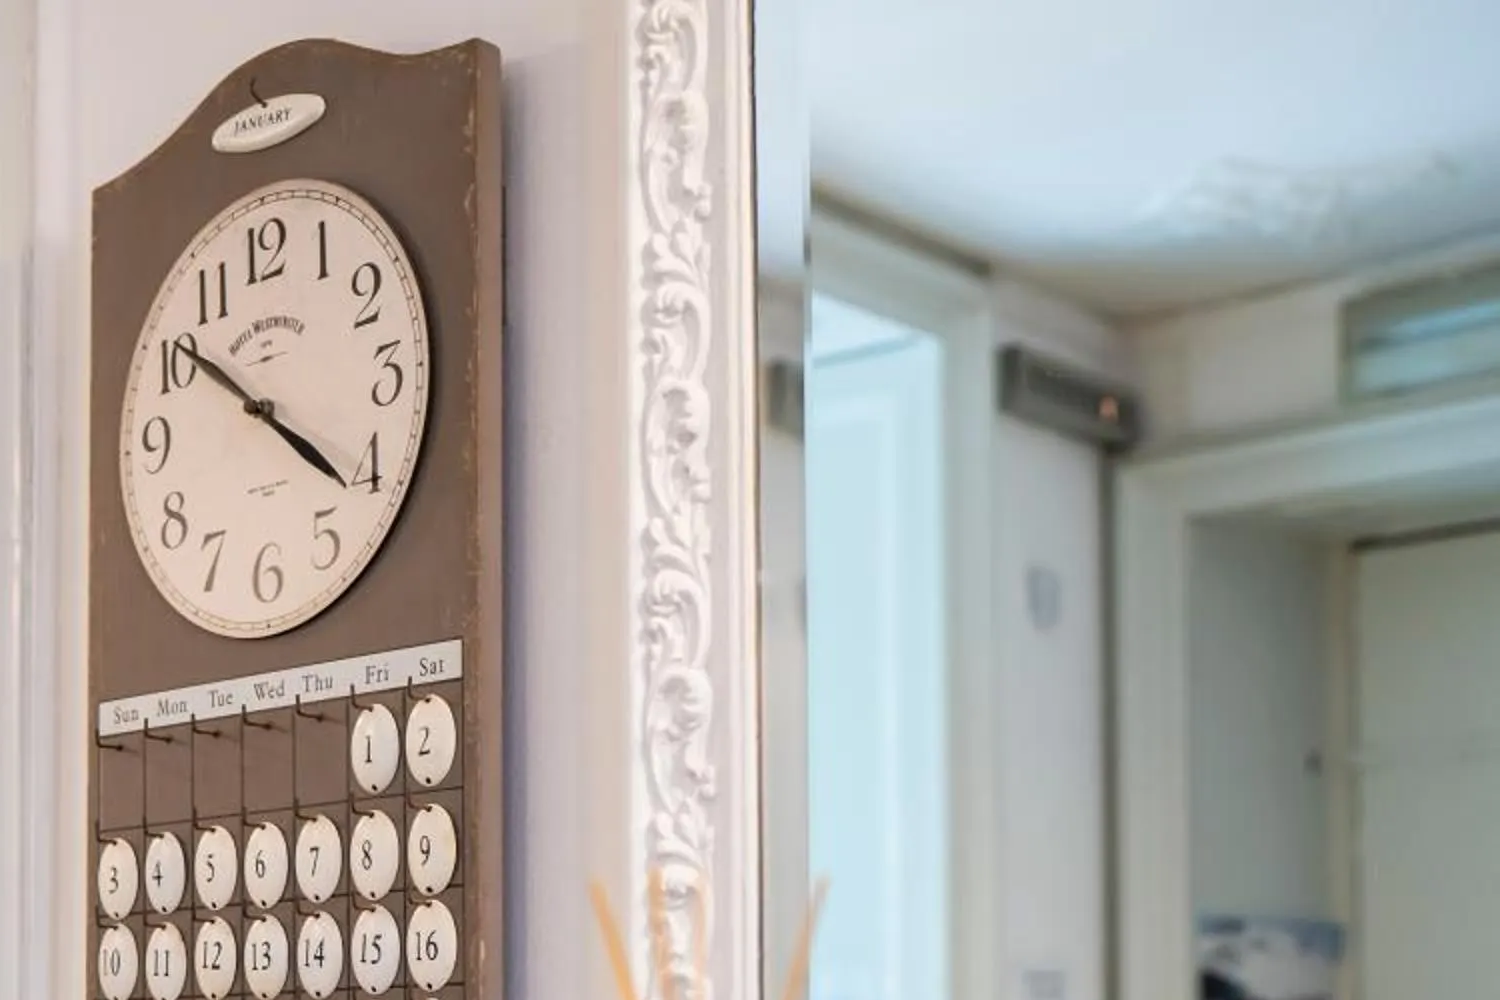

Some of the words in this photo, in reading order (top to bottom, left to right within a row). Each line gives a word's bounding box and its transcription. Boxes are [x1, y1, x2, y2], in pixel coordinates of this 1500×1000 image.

[233, 107, 292, 137] JANUARY
[246, 217, 287, 286] 12
[317, 220, 329, 281] 1
[197, 261, 229, 327] 11
[351, 261, 382, 330] 2
[160, 332, 202, 396] 10
[371, 339, 404, 407] 3
[141, 415, 172, 475] 9
[351, 431, 383, 495] 4
[160, 491, 189, 550] 8
[313, 506, 341, 571] 5
[200, 529, 227, 593] 7
[251, 542, 284, 604] 6
[113, 705, 140, 725] Sun
[156, 699, 188, 717] Mon
[209, 690, 234, 708] Tue
[253, 679, 285, 700] Wed
[302, 673, 334, 693] Thu
[365, 664, 389, 685] Fri
[419, 657, 445, 677] Sat
[364, 735, 373, 764] 1
[417, 726, 431, 757] 2
[107, 866, 120, 895] 3
[151, 861, 164, 888] 4
[205, 853, 217, 884] 5
[254, 849, 267, 879] 6
[309, 845, 321, 877] 7
[361, 839, 373, 871] 8
[419, 835, 431, 867] 9
[103, 947, 122, 977] 10
[153, 949, 171, 978] 11
[201, 941, 223, 971] 12
[251, 940, 272, 971] 13
[304, 938, 325, 969] 14
[359, 933, 383, 965] 15
[415, 929, 439, 962] 16
